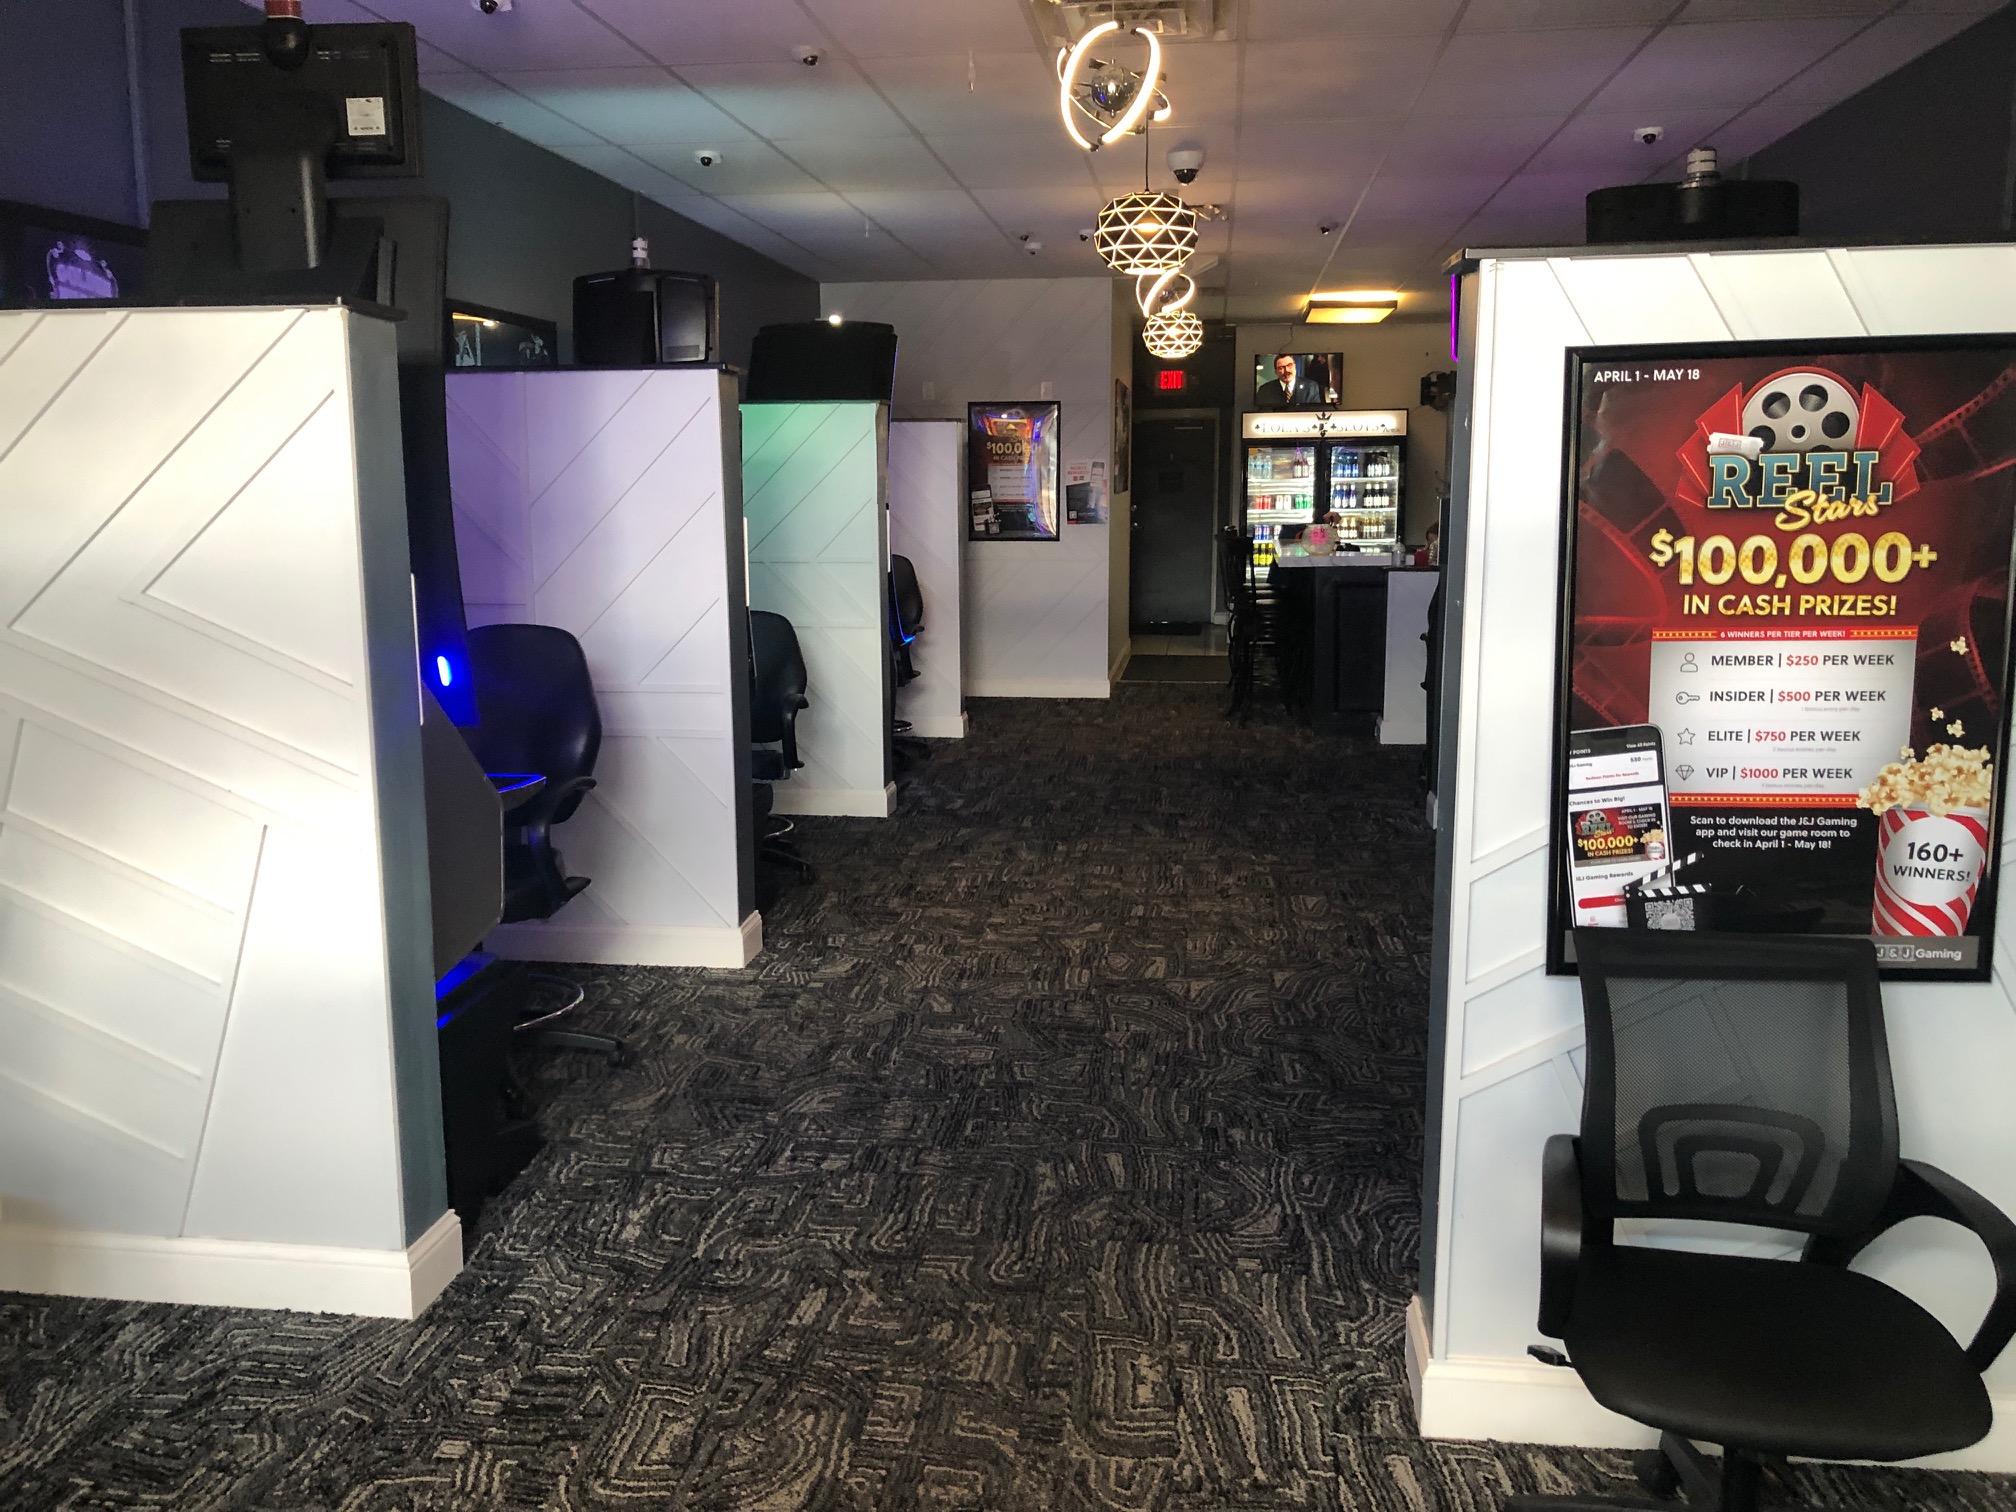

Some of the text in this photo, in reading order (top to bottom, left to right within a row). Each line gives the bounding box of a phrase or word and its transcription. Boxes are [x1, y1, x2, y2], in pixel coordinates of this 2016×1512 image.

[1160, 370, 1183, 389] EXIT
[1594, 370, 1633, 382] APRIL
[1635, 370, 1641, 382] 1
[1653, 369, 1680, 381] MAY
[1682, 369, 1701, 381] 18
[1707, 451, 1893, 508] REEL
[1775, 489, 1880, 532] Stars
[1649, 528, 1938, 589] $100,000+
[1683, 594, 1897, 615] IN CASH PRIZES!
[1727, 631, 1765, 639] WINNERS
[1767, 631, 1782, 639] PER
[1784, 631, 1800, 639] TIER
[1802, 631, 1817, 639] PER
[1819, 631, 1846, 639] WEEK!
[1711, 655, 1774, 666] MEMBER
[1786, 654, 1819, 667] $250
[1823, 655, 1848, 666] PER
[1853, 654, 1895, 665] WEEK
[1709, 691, 1765, 702] INSIDER
[1778, 690, 1811, 703] $500
[1815, 691, 1840, 702] PER
[1845, 691, 1886, 702] WEEK
[1708, 731, 1743, 742] ELITE
[1755, 730, 1786, 743] $750
[1790, 731, 1815, 741] PER
[1820, 731, 1861, 741] WEEK
[1706, 768, 1728, 778] VIP
[1740, 767, 1779, 780] $1000
[1783, 768, 1808, 779] PER
[1812, 768, 1853, 779] WEEK
[1569, 798, 1593, 807] Chances
[1613, 796, 1625, 804] Big!
[1690, 816, 1858, 828] Scan to download the J&J Gaming
[1695, 829, 1715, 838] app
[1717, 828, 1736, 837] and
[1738, 828, 1758, 837] visit
[1779, 830, 1808, 839] game
[1810, 830, 1837, 838] room
[1839, 829, 1850, 838] to
[1577, 835, 1638, 851] $100,000+
[1712, 839, 1741, 848] check
[1743, 839, 1753, 848] in
[1755, 840, 1778, 851] April
[1794, 840, 1816, 851] May
[1818, 840, 1832, 849] 18!
[1595, 849, 1611, 857] CASH
[1907, 842, 1964, 862] 160+
[1586, 873, 1608, 881] Gaming
[1609, 871, 1633, 879] Rewards
[1893, 865, 1971, 882] WINNERS!
[1915, 948, 1962, 961] Gaming
